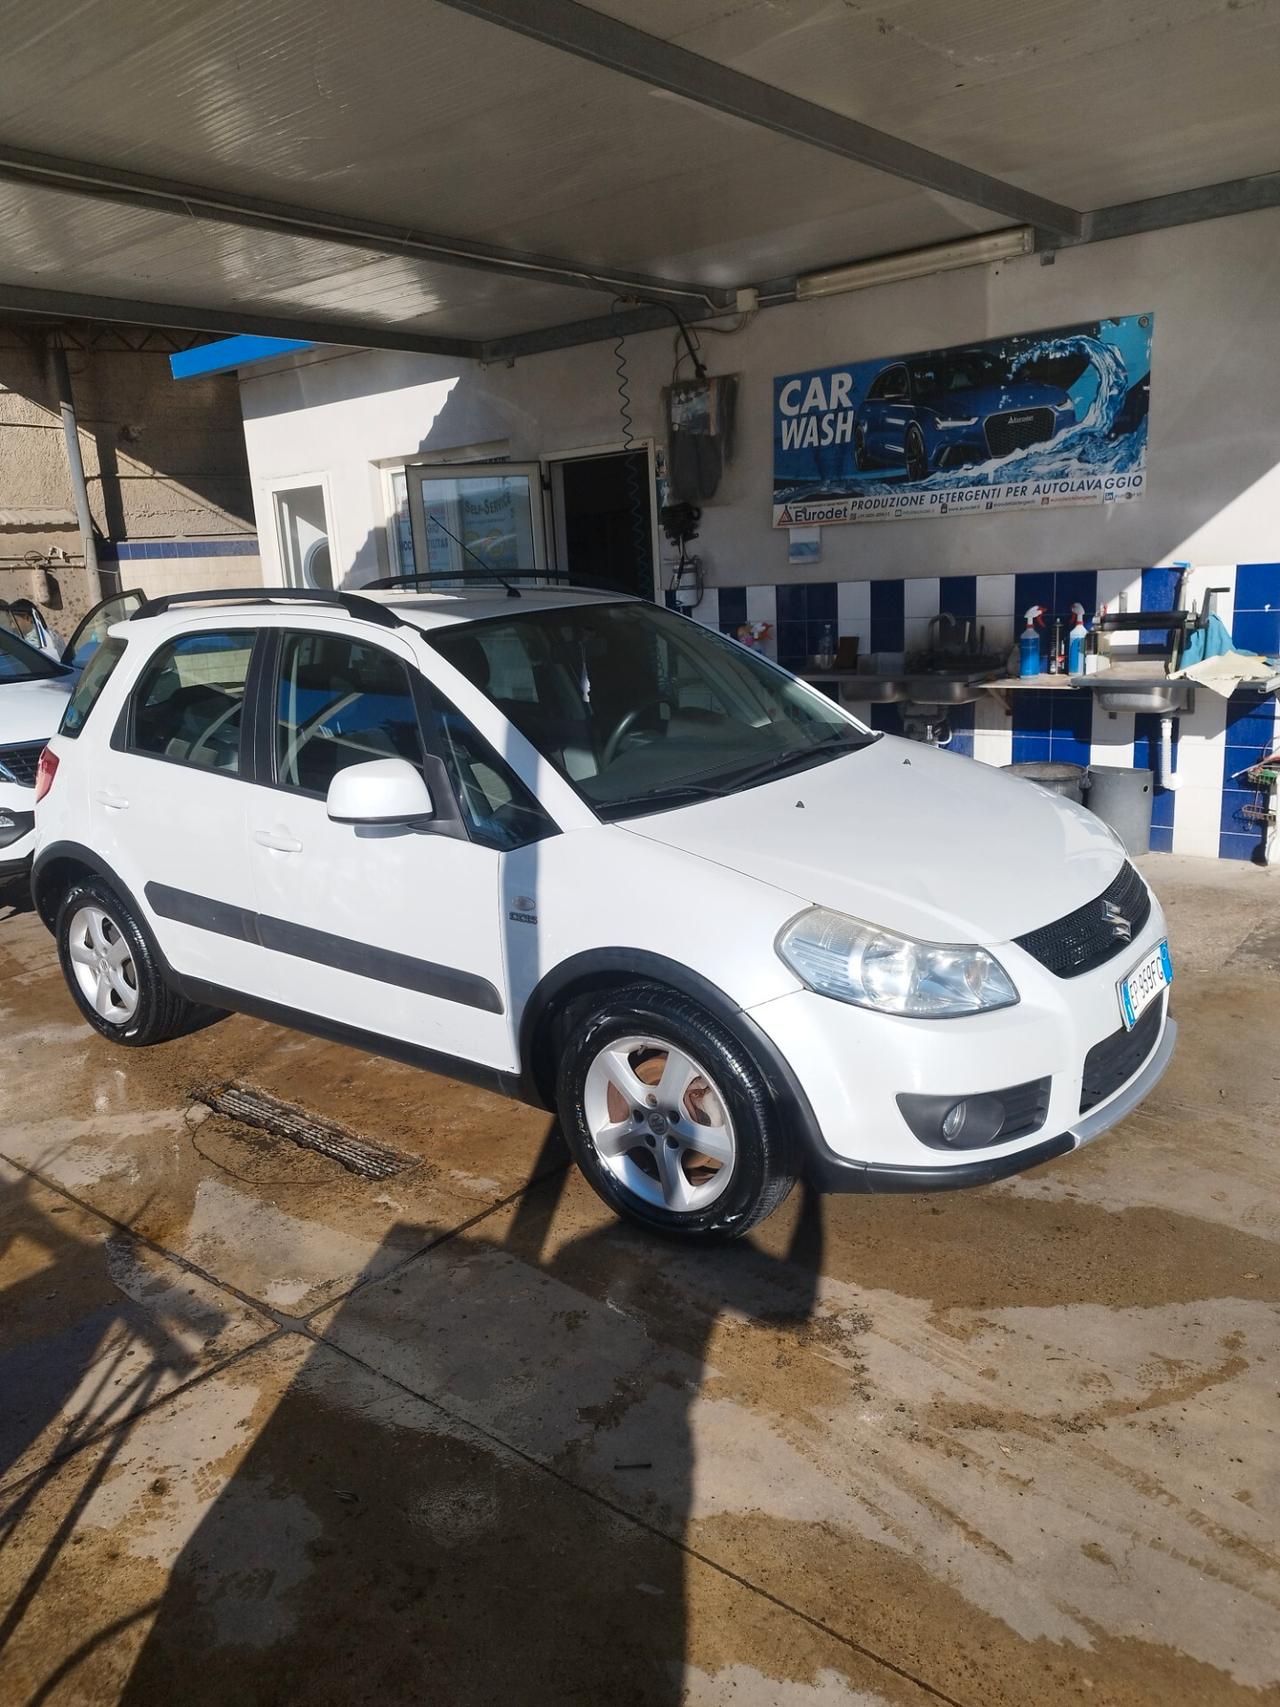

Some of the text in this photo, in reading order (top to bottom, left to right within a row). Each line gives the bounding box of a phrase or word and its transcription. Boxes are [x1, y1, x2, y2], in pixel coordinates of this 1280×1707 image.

[779, 373, 853, 416] CAR
[781, 410, 854, 451] WASH
[851, 495, 926, 511] PRODUZIONE
[930, 487, 1002, 504] DETERGENTI
[1005, 485, 1028, 498] PER
[1032, 475, 1143, 495] AUTOLAVAGGIO
[795, 506, 848, 522] Eurodet
